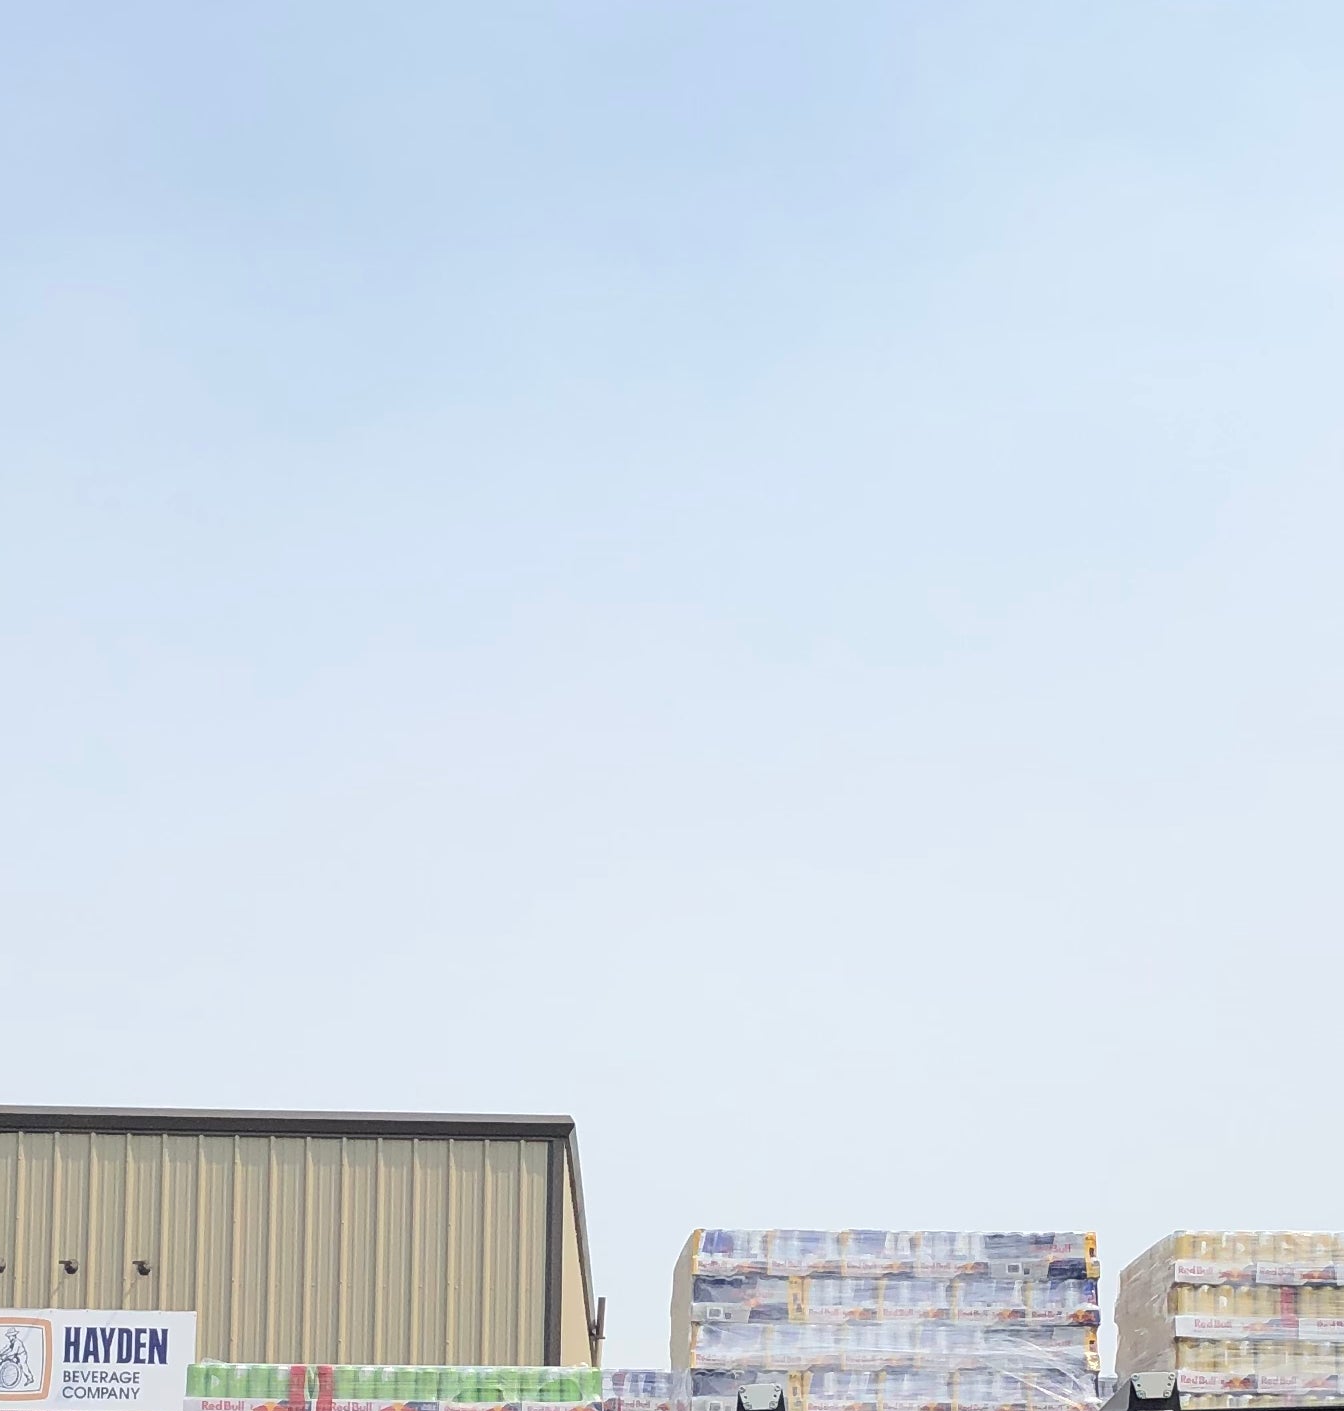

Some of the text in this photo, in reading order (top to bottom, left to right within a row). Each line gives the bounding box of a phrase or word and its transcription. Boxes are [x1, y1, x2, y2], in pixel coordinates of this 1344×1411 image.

[63, 1327, 169, 1365] HAYDEN
[63, 1370, 141, 1384] BEVERAGE
[62, 1386, 141, 1400] COMPANY
[202, 1401, 245, 1411] Red Bull
[331, 1402, 373, 1411] Red Bull
